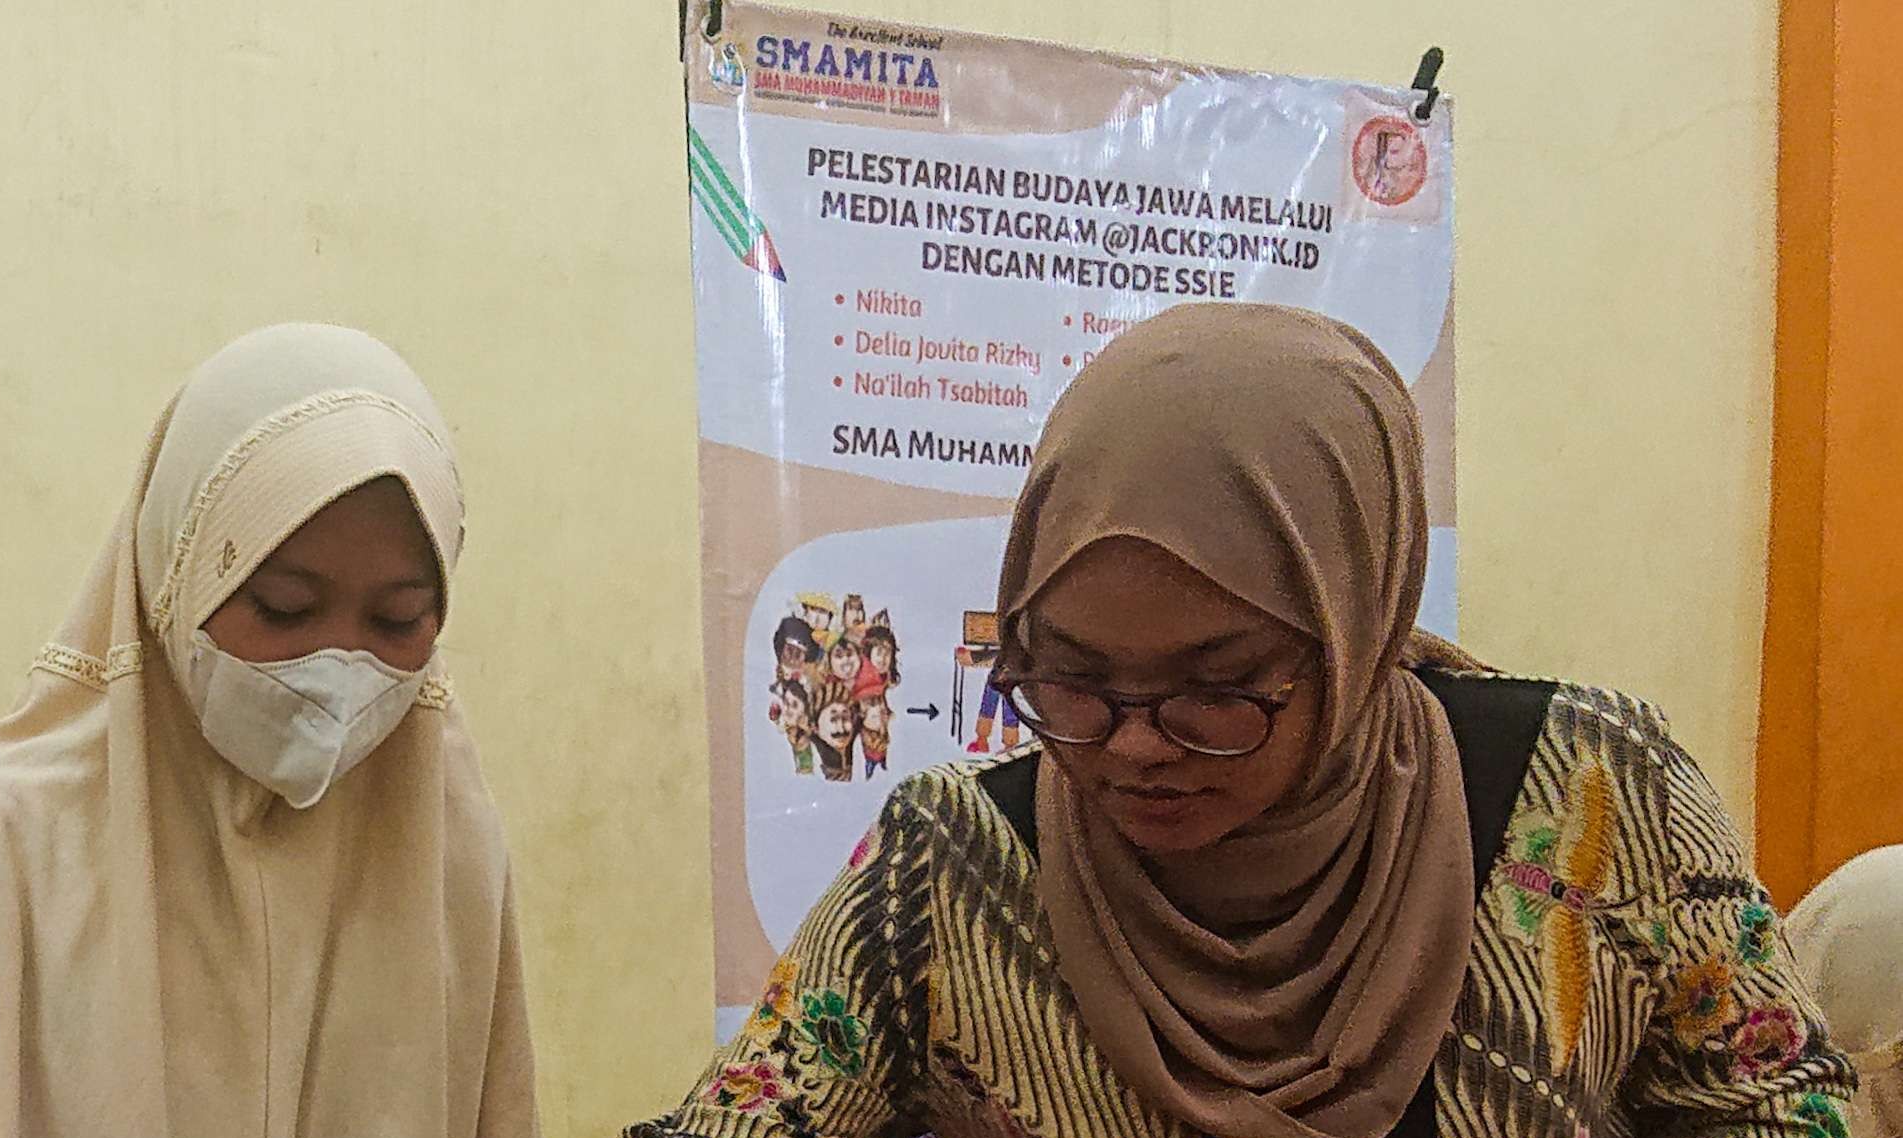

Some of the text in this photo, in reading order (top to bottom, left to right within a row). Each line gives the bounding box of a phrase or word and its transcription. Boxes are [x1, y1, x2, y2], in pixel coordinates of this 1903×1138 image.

[755, 36, 939, 88] SMAMITA
[807, 147, 1333, 233] PELESTARIAN BUDAYA JAWA MELALUI
[820, 190, 919, 229] MEDIA
[926, 201, 1097, 246] INSTAGRAM
[921, 241, 1236, 298] DENGAN METODE SSIE
[855, 289, 922, 318] Nikita
[855, 330, 911, 358] Delia
[985, 341, 1041, 376] Rizky
[854, 371, 1029, 409] Na'ilah Tsabitah
[832, 424, 901, 459] SMA
